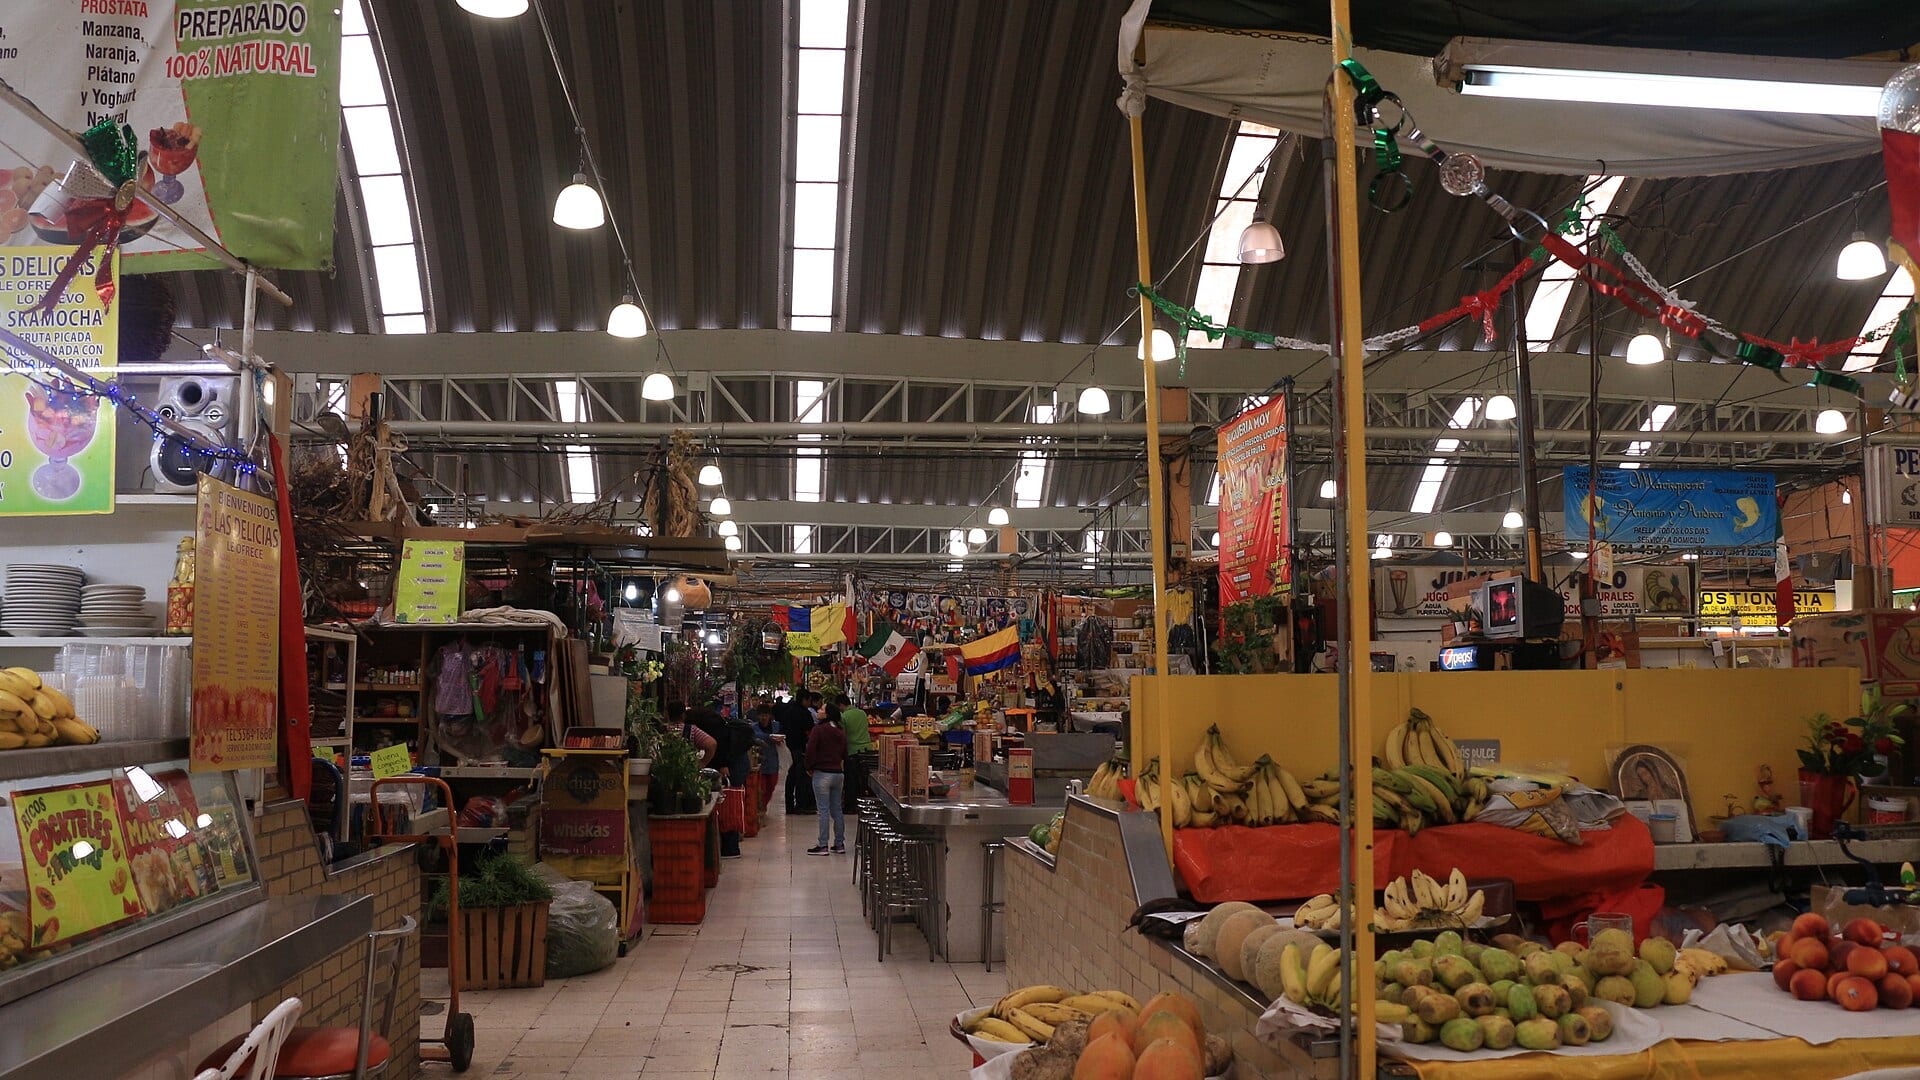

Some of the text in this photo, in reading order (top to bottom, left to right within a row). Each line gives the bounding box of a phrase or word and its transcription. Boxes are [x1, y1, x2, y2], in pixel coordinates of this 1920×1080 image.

[81, 0, 148, 17] PROSTATA
[179, 3, 305, 38] PREPARADO
[82, 21, 144, 43] Manzana,
[86, 44, 140, 64] Naranja,
[166, 43, 315, 78] 100% NATURAL
[88, 66, 135, 84] Plátano
[81, 88, 137, 109] y Yoghurt
[17, 294, 34, 305] LO
[20, 331, 91, 342] FRUTA PICADA
[82, 344, 103, 355] CON
[1253, 411, 1270, 429] MOY
[218, 490, 276, 522] BIENVENIDOS
[214, 510, 279, 548] LAS DELICIAS
[236, 543, 263, 560] OFRECE
[1453, 649, 1473, 667] pepsi
[22, 796, 47, 832] RICOS
[554, 822, 610, 838] whiskas
